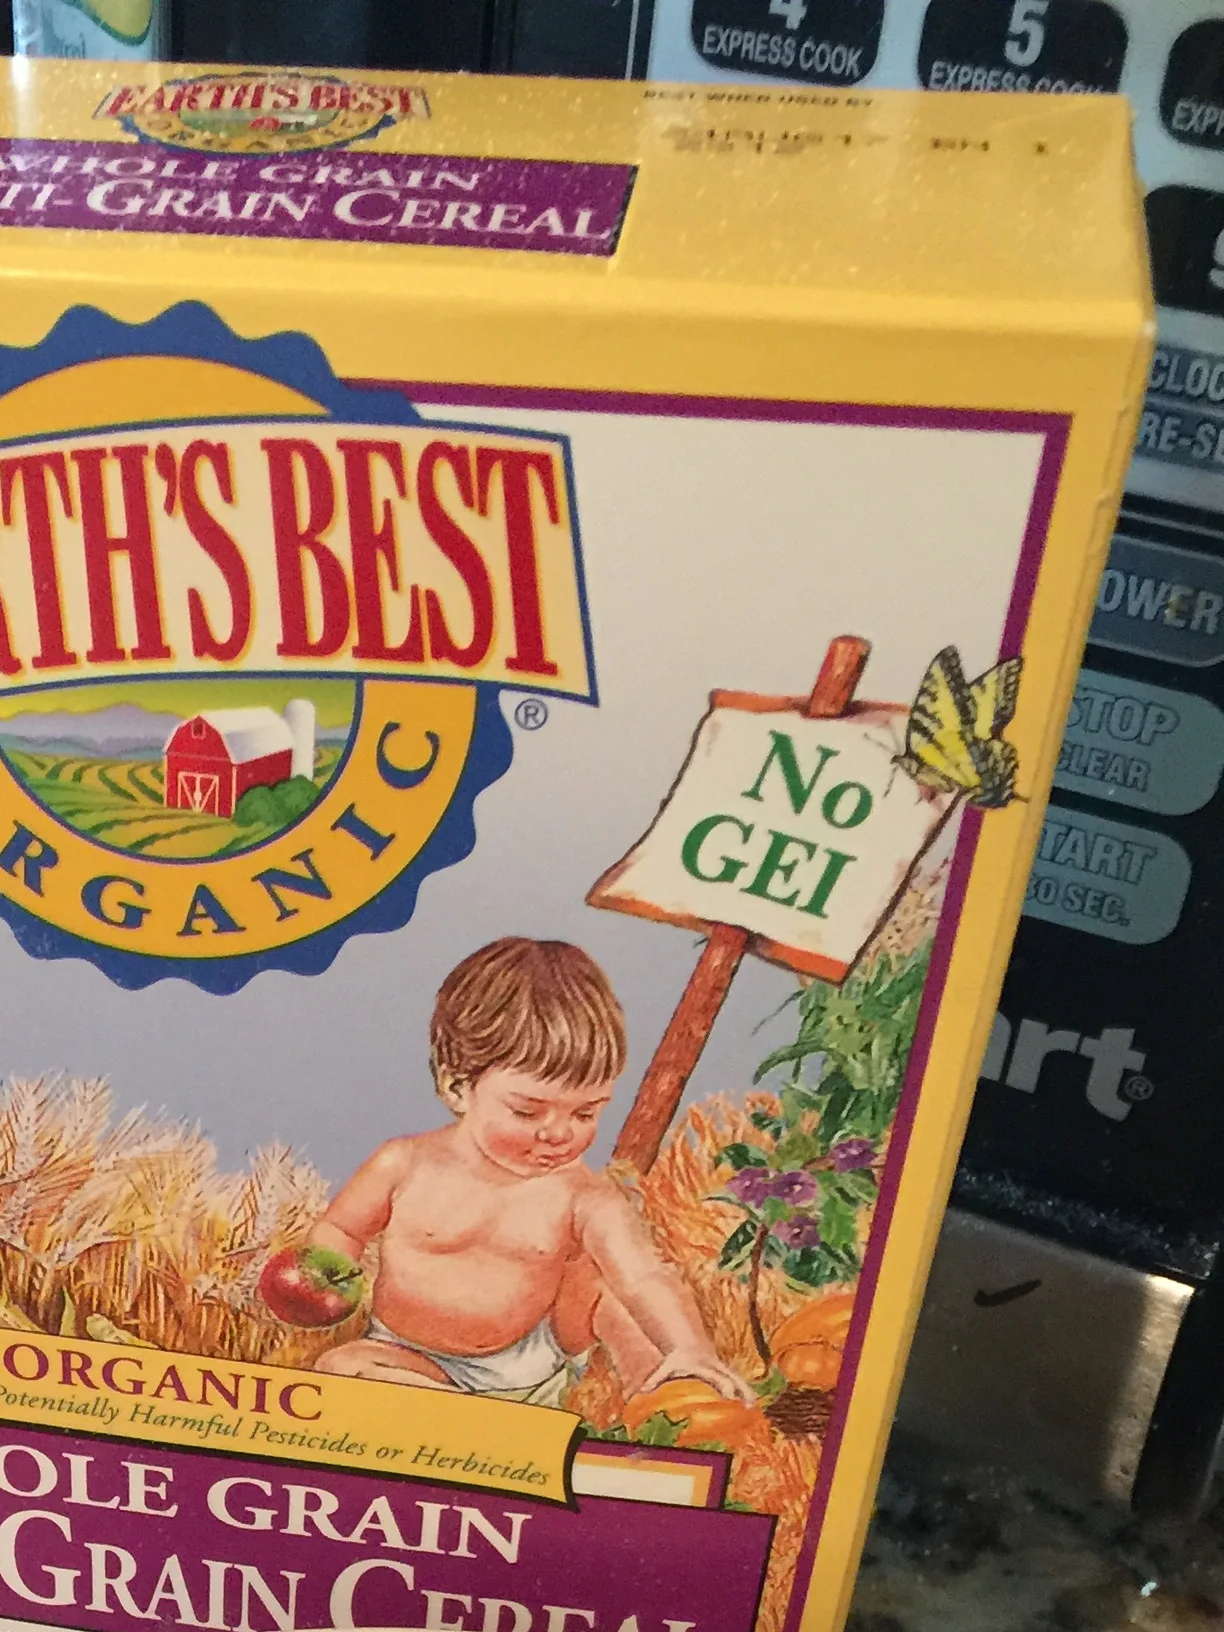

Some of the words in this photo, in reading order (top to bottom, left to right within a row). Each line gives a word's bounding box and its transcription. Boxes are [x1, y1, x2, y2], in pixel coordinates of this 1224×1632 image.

[702, 24, 797, 69] EXPRESS
[799, 37, 863, 79] COOK
[1003, 0, 1051, 67] 5
[107, 83, 299, 117] EARTH'S
[310, 82, 415, 115] BEST
[929, 60, 1031, 93] EXPRESS
[259, 163, 483, 192] GRAIN
[334, 187, 618, 241] CEREAL
[260, 437, 562, 678] BEST
[742, 730, 874, 830] No
[681, 812, 858, 920] GEI
[1061, 881, 1131, 927] SEC.
[3, 1343, 322, 1422] ORGANIC
[129, 1403, 243, 1442] Harmful
[249, 1420, 367, 1458] Pesticides
[375, 1445, 403, 1462] or
[410, 1444, 550, 1486] Herbicides
[207, 1476, 532, 1565] GRAIN
